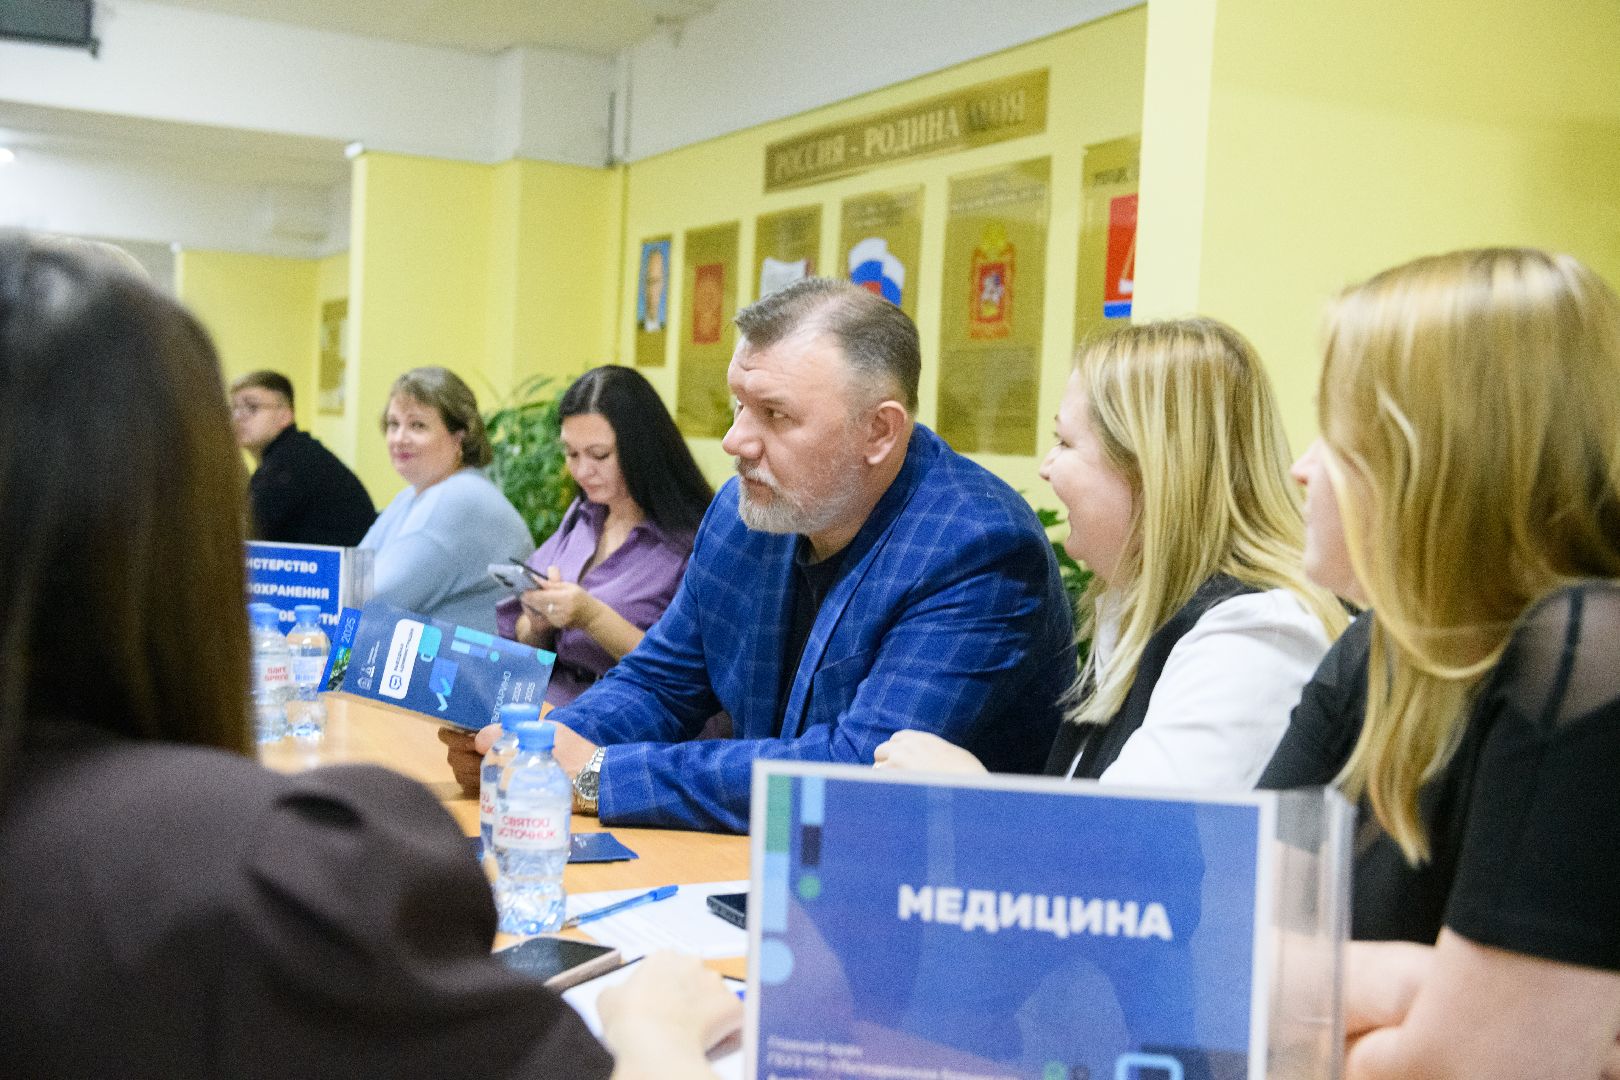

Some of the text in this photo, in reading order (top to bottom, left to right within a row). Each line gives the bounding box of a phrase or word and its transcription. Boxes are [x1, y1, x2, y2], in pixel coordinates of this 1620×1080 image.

[863, 107, 960, 157] РОДИНА
[246, 557, 318, 574] ИСТЕРСТВО
[248, 582, 330, 600] ОХРАНЕНИЯ
[278, 609, 339, 626] ОБТИ
[340, 616, 356, 643] 2025
[899, 884, 1173, 941] МЕДИЦИНА
